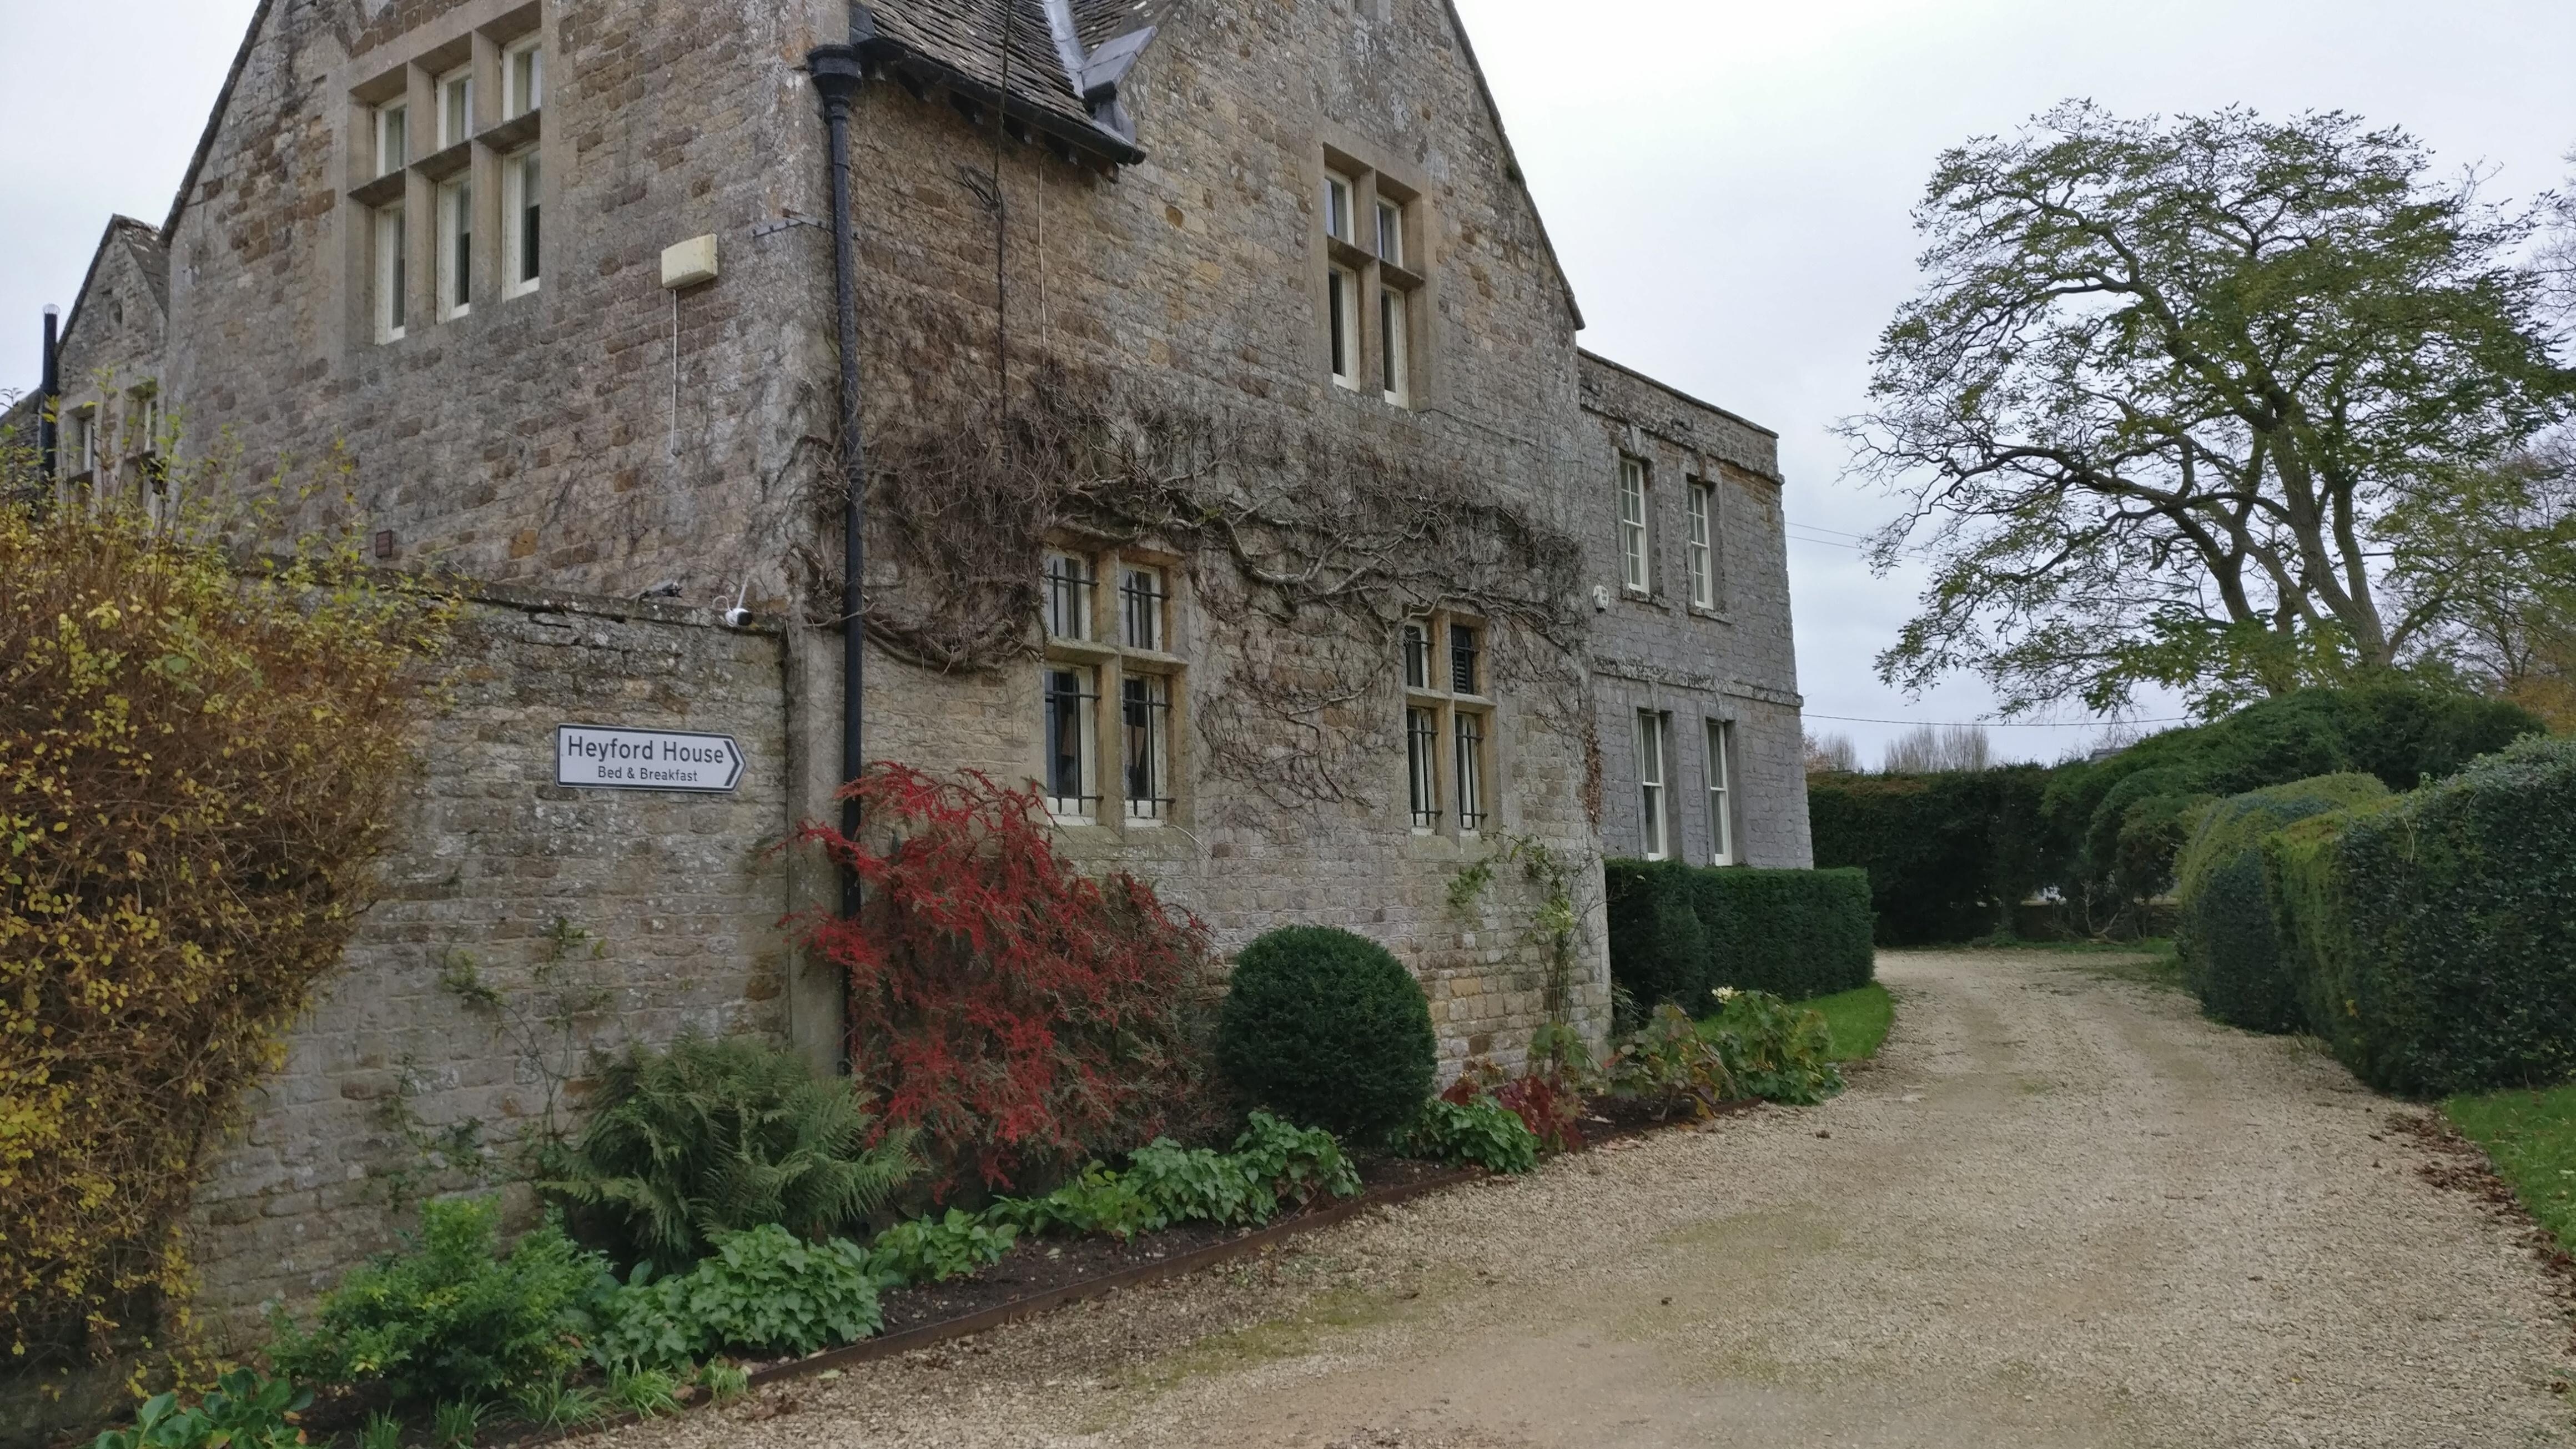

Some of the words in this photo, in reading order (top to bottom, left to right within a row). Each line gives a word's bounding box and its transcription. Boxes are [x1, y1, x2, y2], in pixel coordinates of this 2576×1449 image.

[568, 735, 653, 762] Heyford
[663, 741, 724, 764] House
[598, 766, 622, 779] Bed
[627, 767, 635, 779] &
[640, 767, 698, 782] Breakfast
